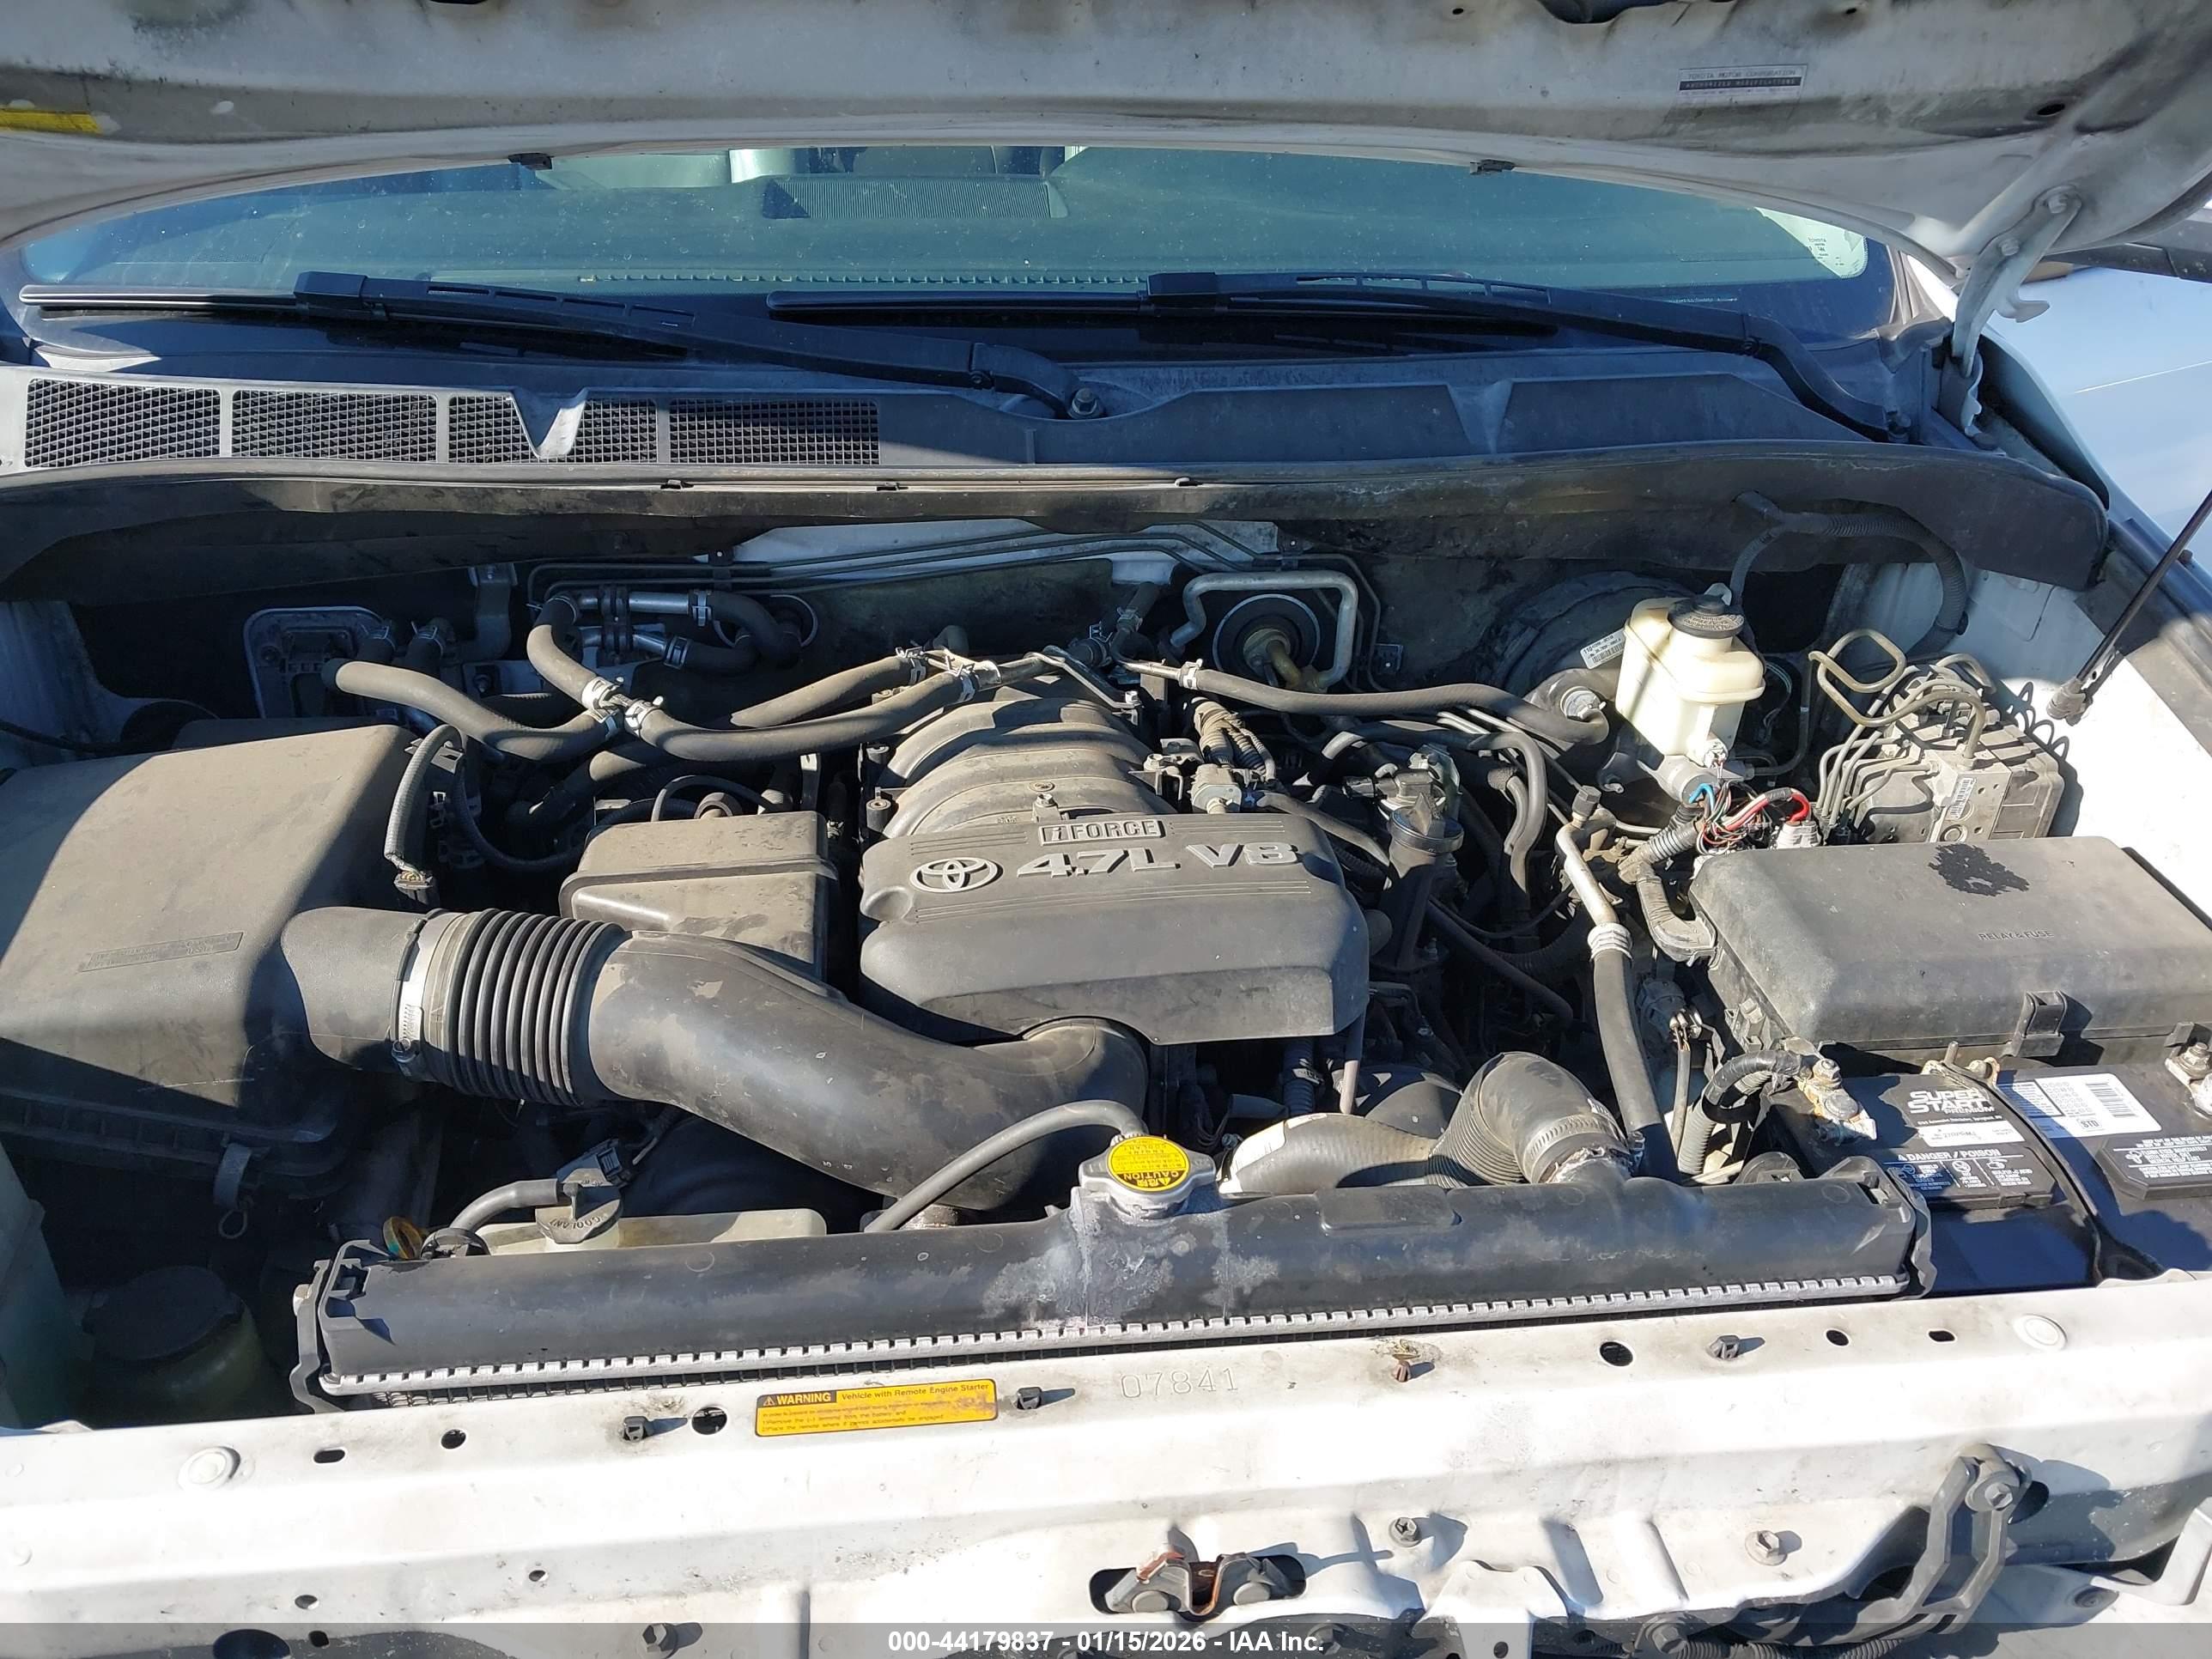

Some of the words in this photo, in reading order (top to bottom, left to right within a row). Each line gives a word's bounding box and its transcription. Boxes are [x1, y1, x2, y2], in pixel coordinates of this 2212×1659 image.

[1017, 848, 1178, 878] 4.7L
[1185, 842, 1298, 869] V8
[1909, 1088, 1986, 1103] SUPER
[1907, 1098, 1990, 1114] START
[1905, 1152, 1952, 1162] DANGER
[1959, 1148, 2002, 1159] POISON
[1123, 1170, 1179, 1180] CAUTION
[550, 1216, 601, 1229] COOLANT
[1121, 1366, 1238, 1399] 07841
[776, 1392, 831, 1405] WARNING
[842, 1391, 872, 1401] Vehicle
[874, 1389, 892, 1398] with
[894, 1388, 927, 1396] Remote
[929, 1386, 958, 1395] Engine
[961, 1383, 990, 1392] Starter
